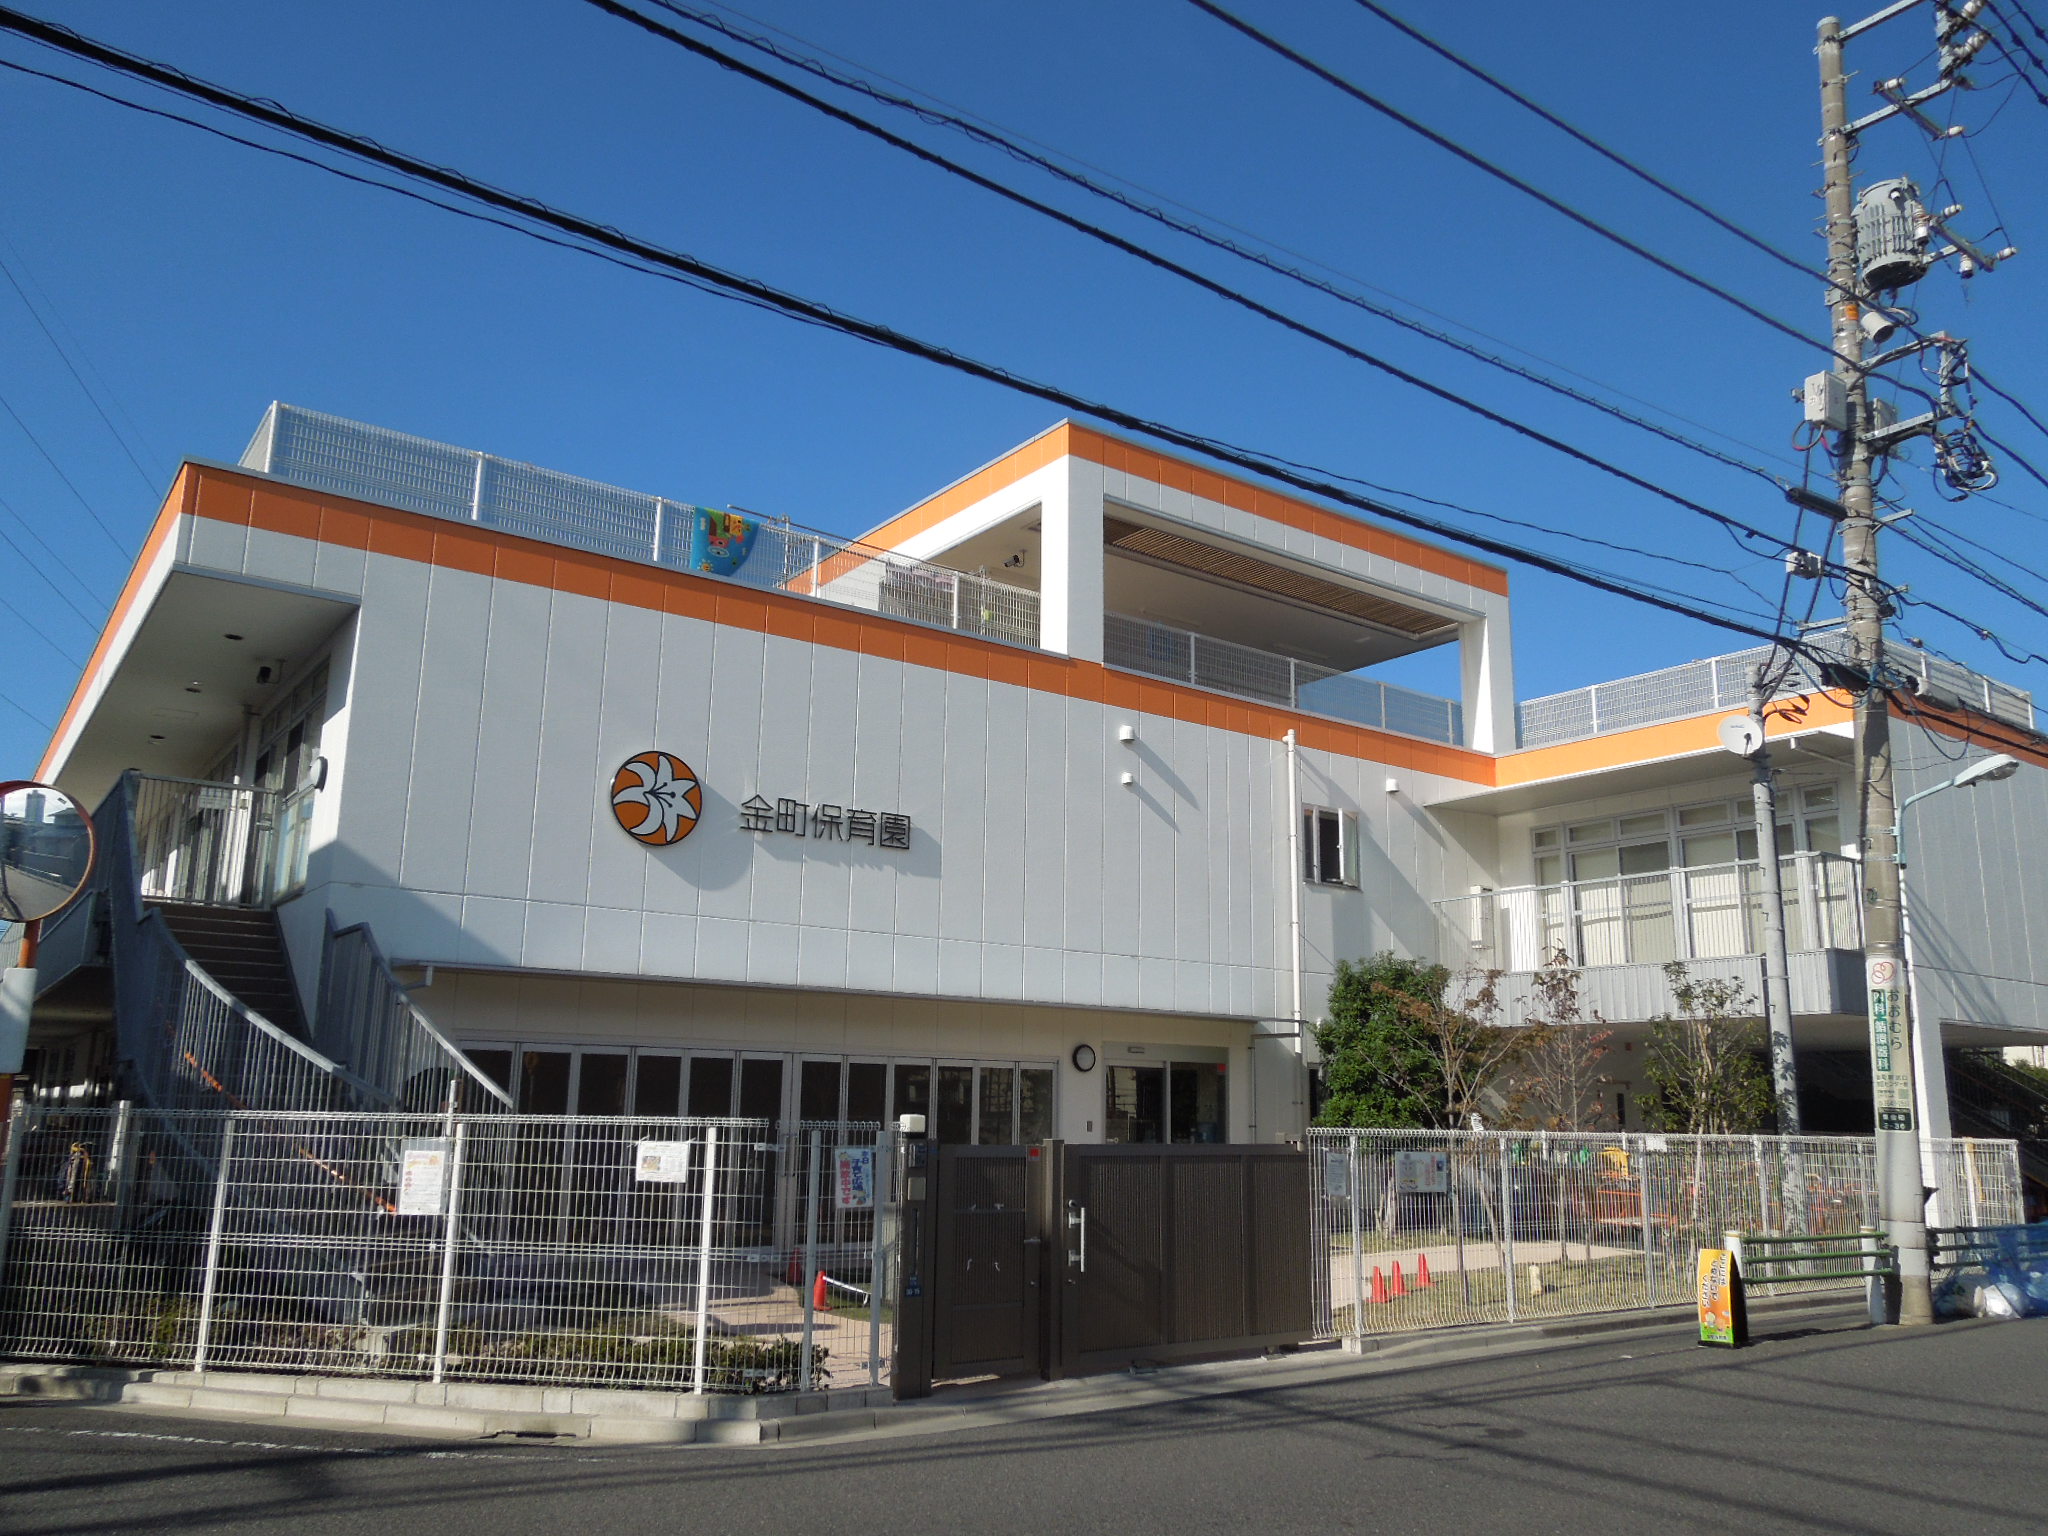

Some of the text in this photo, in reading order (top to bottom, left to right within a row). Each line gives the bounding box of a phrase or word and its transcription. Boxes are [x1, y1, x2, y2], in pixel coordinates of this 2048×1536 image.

[740, 794, 911, 850] 金町保育園
[1887, 989, 1903, 1050] おおむら
